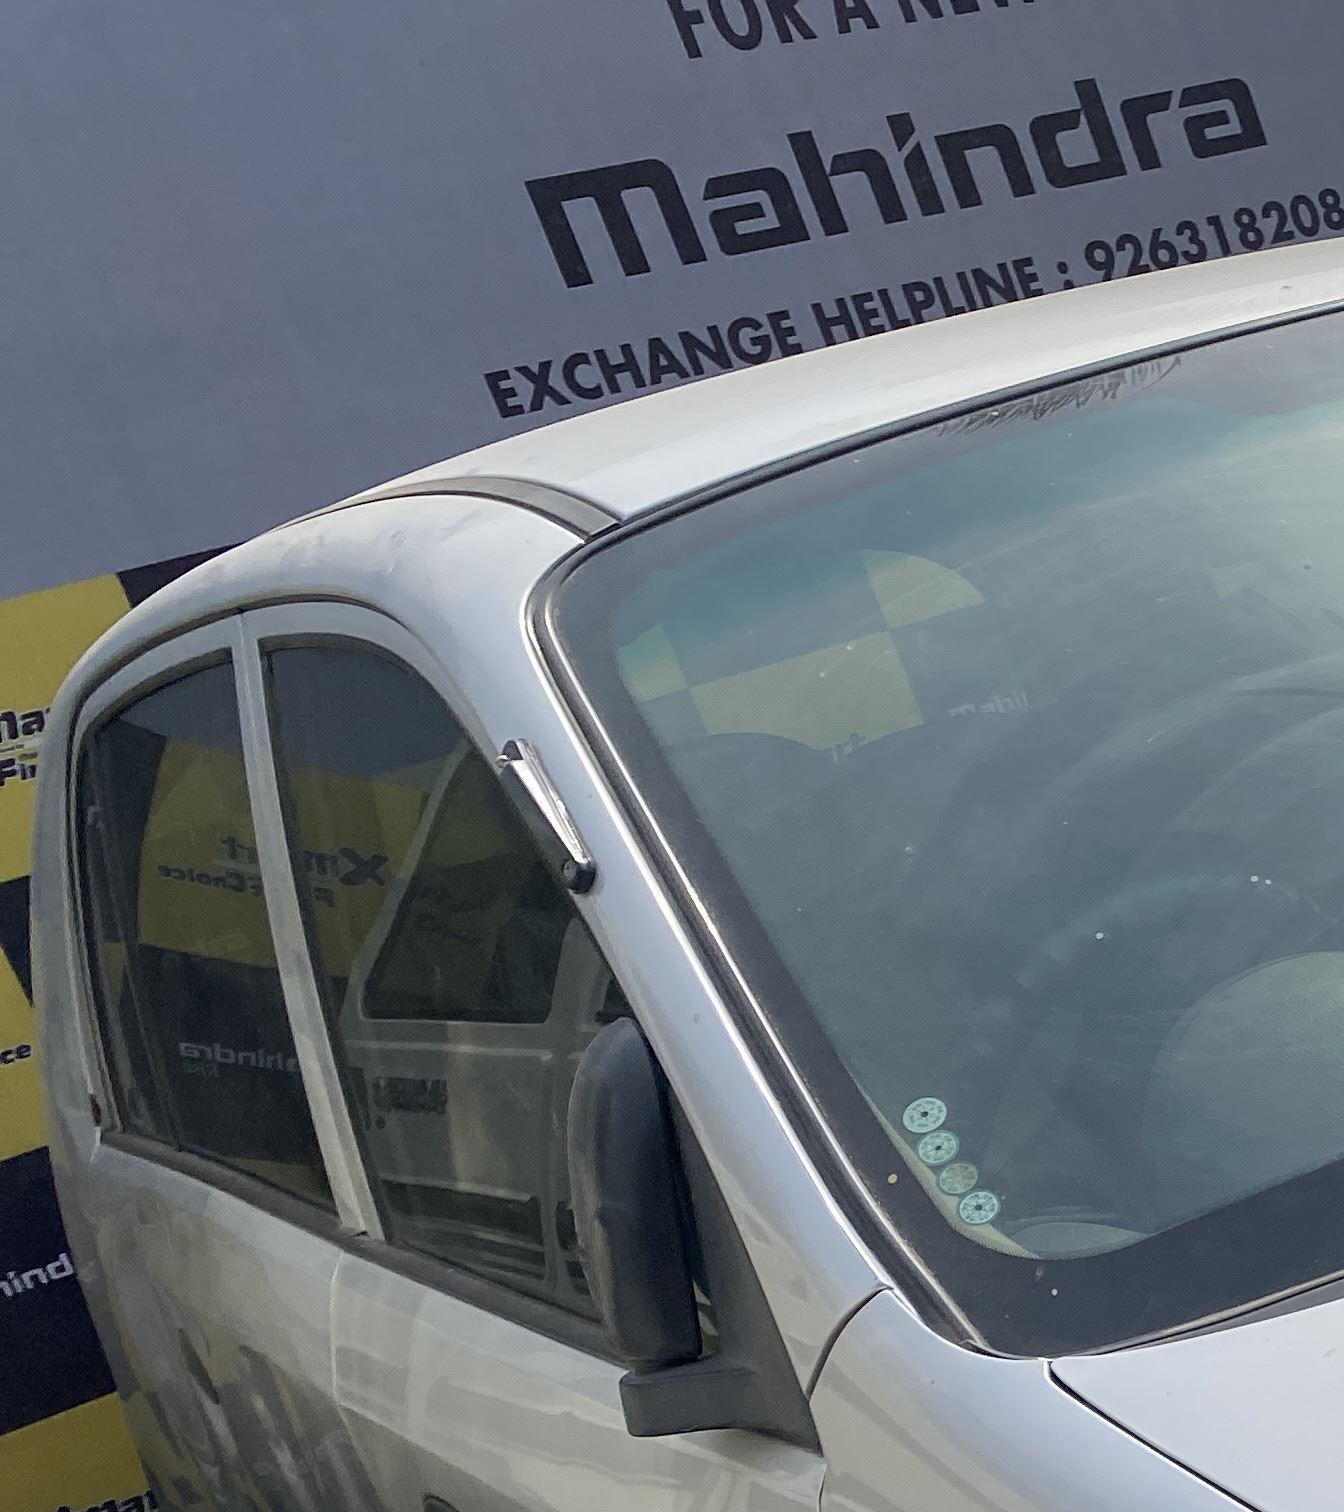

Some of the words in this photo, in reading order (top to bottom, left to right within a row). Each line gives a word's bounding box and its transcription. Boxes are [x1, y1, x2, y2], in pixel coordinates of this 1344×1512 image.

[671, 0, 818, 58] FOR
[526, 78, 1267, 288] Mahindra
[483, 310, 802, 419] EXCHANGE
[811, 256, 1044, 347] HELPLINE
